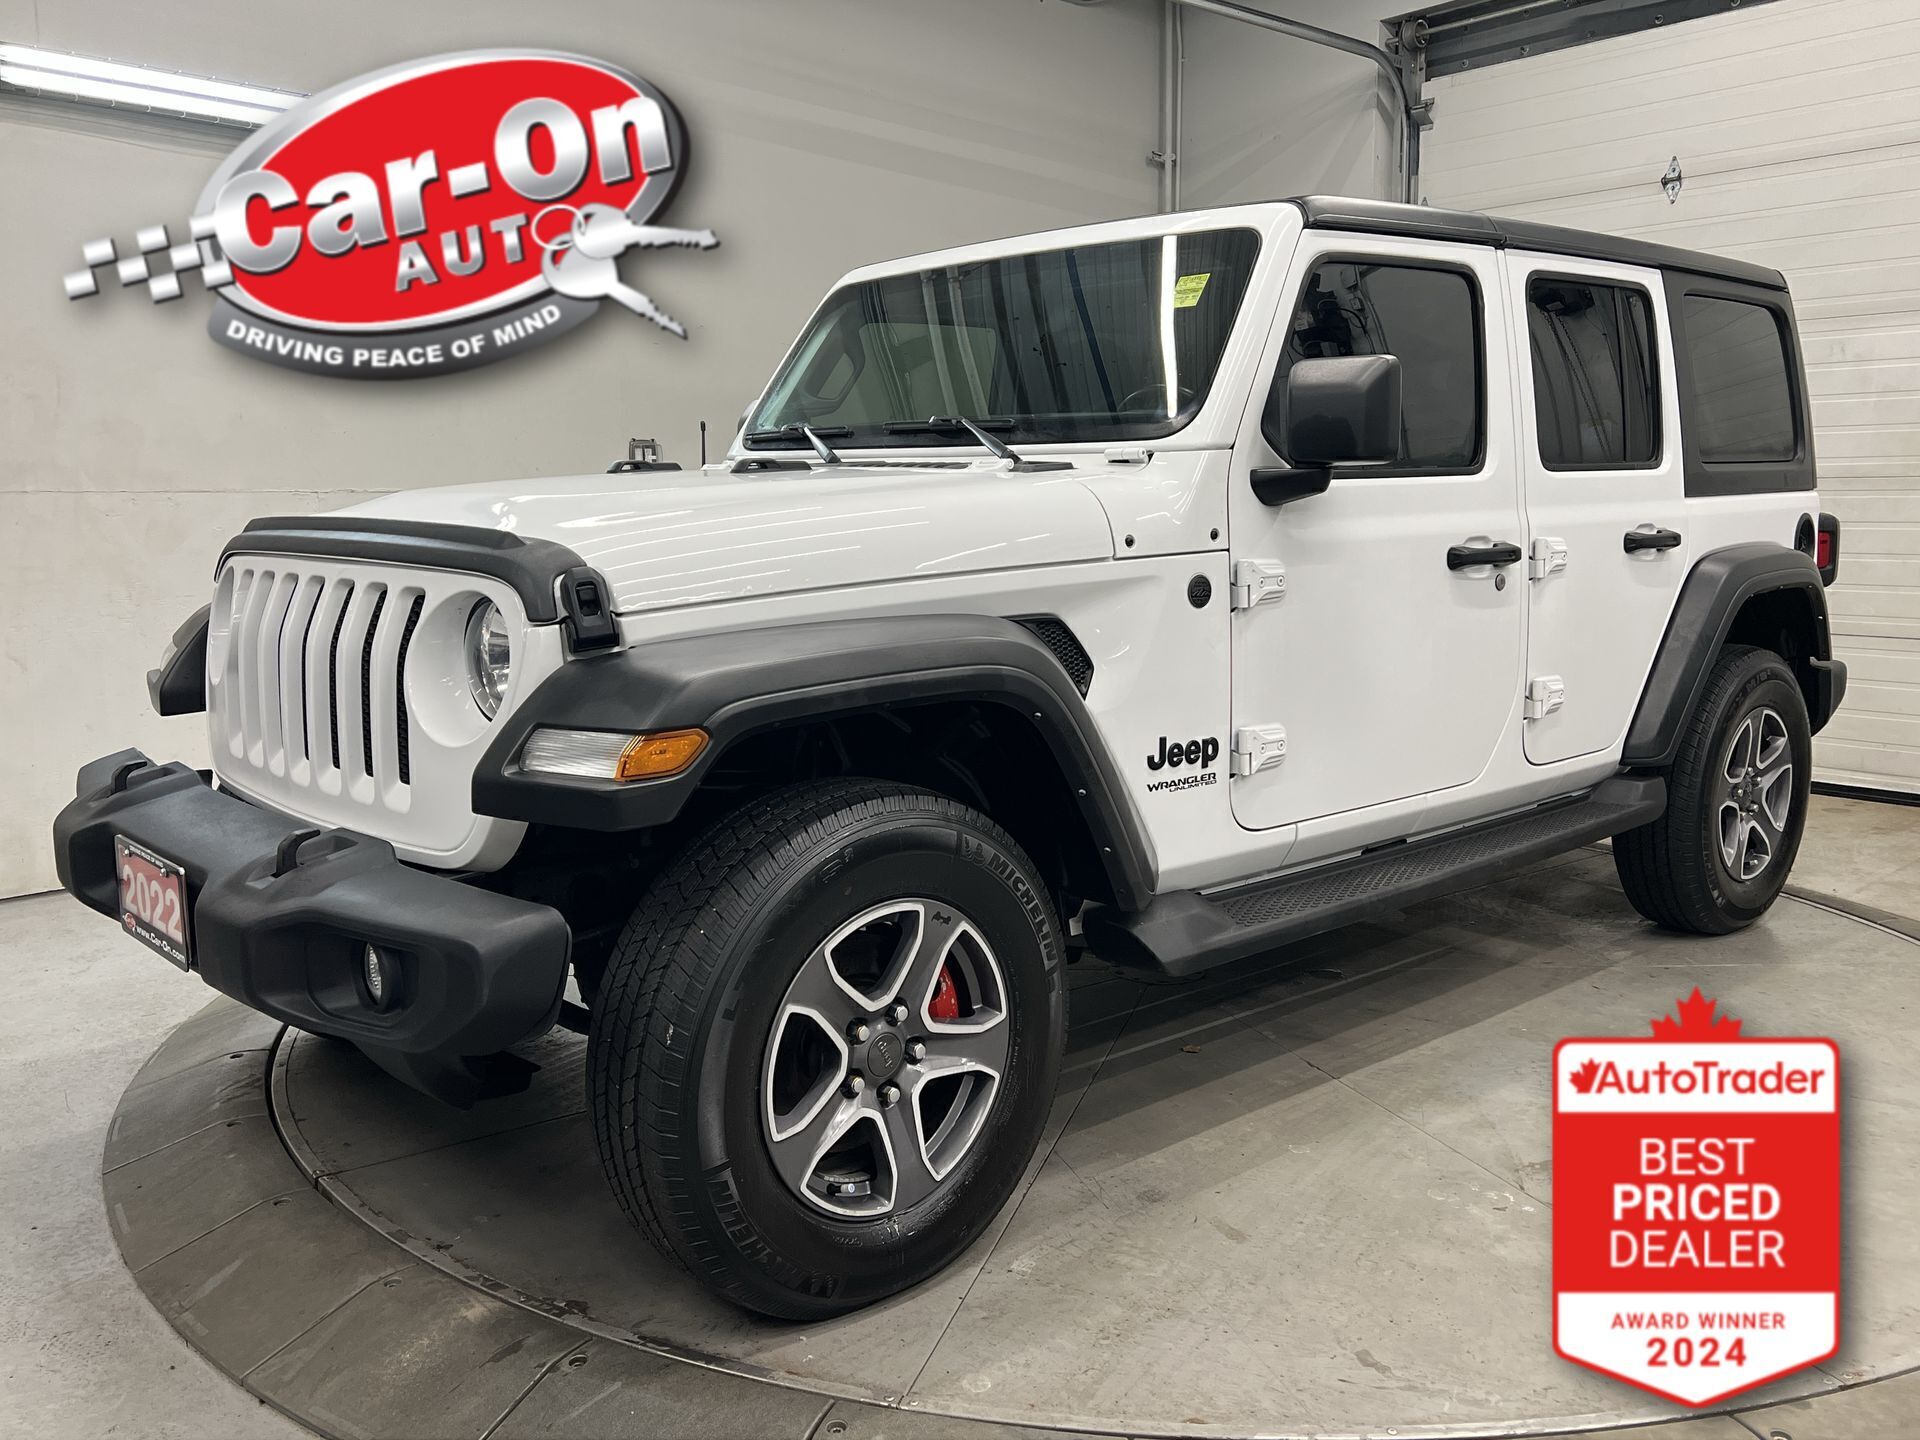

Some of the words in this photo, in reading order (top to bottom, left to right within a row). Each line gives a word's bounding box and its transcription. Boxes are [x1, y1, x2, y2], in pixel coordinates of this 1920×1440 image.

[1146, 736, 1219, 770] Jeep
[1146, 772, 1216, 793] WRANGLER
[121, 864, 183, 945] 2022
[988, 851, 1059, 963] MICHELIN
